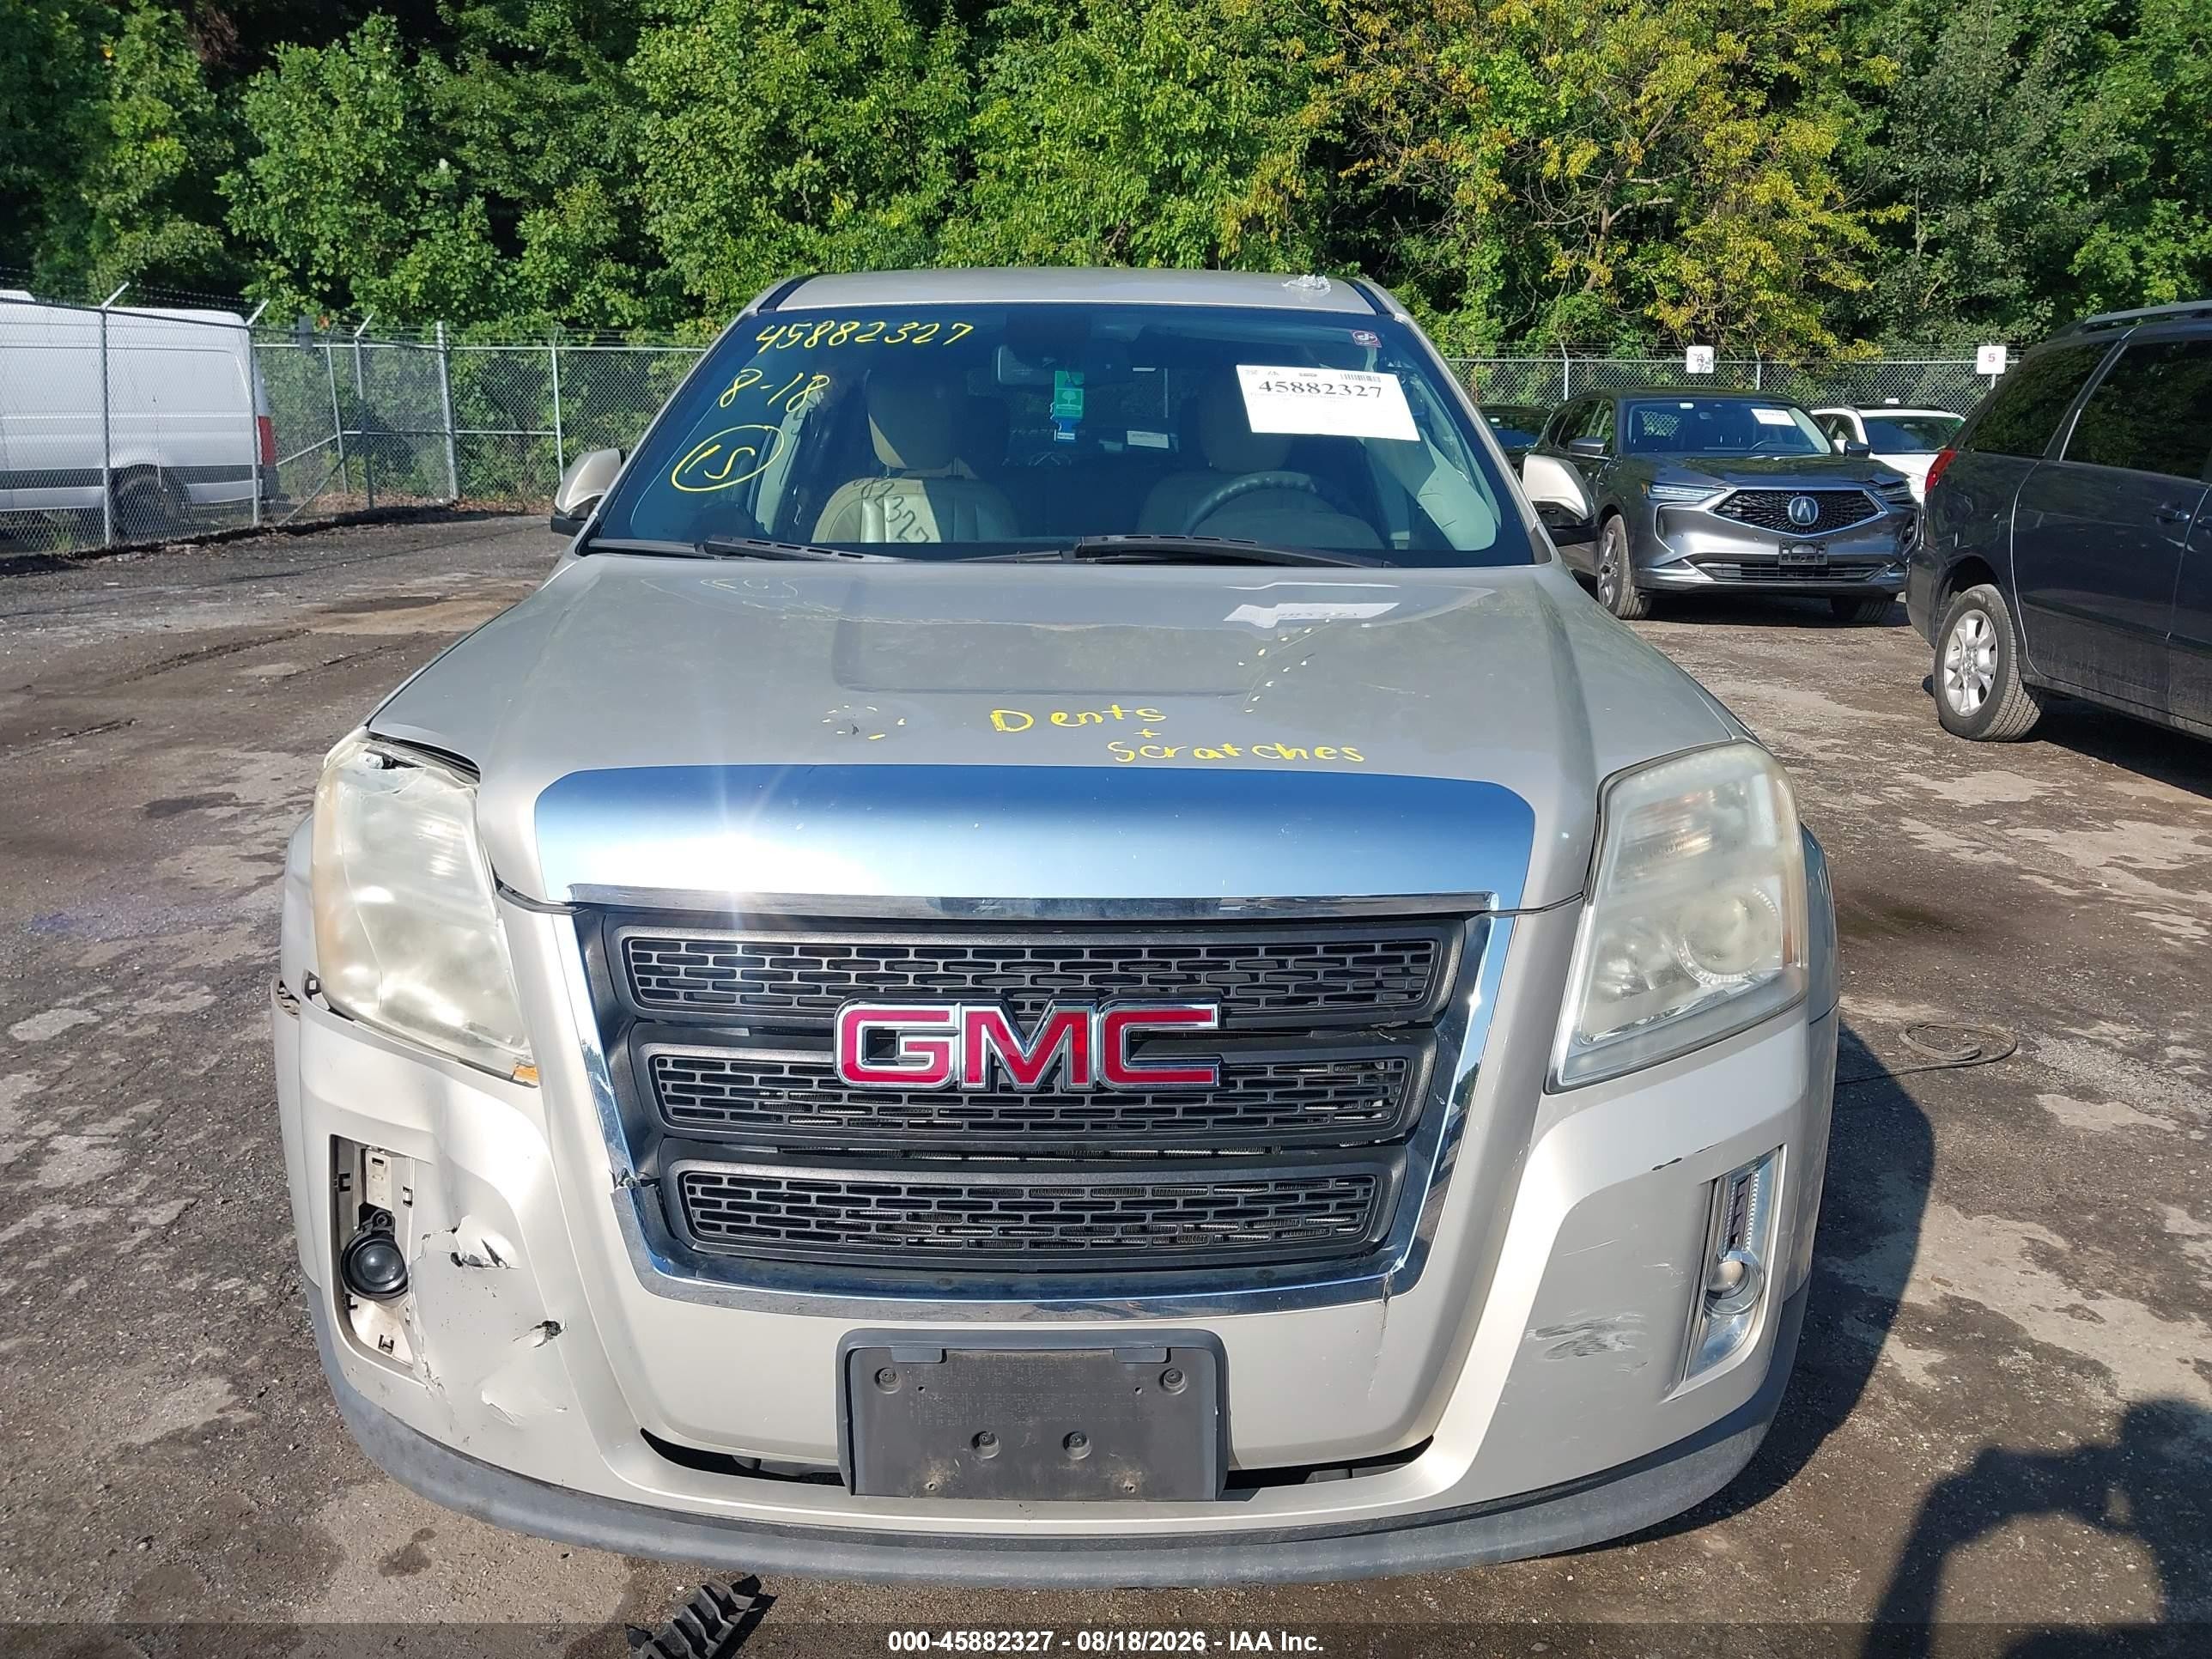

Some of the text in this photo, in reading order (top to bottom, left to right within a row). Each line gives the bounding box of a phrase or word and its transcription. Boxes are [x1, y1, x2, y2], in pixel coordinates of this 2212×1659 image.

[756, 320, 974, 354] 45882327
[1987, 352, 1996, 362] 5
[720, 368, 830, 412] 8-18
[1258, 380, 1382, 398] 45882327
[989, 704, 1167, 732] Dents
[1107, 740, 1366, 763] Scratches
[834, 999, 1222, 1092] GMC
